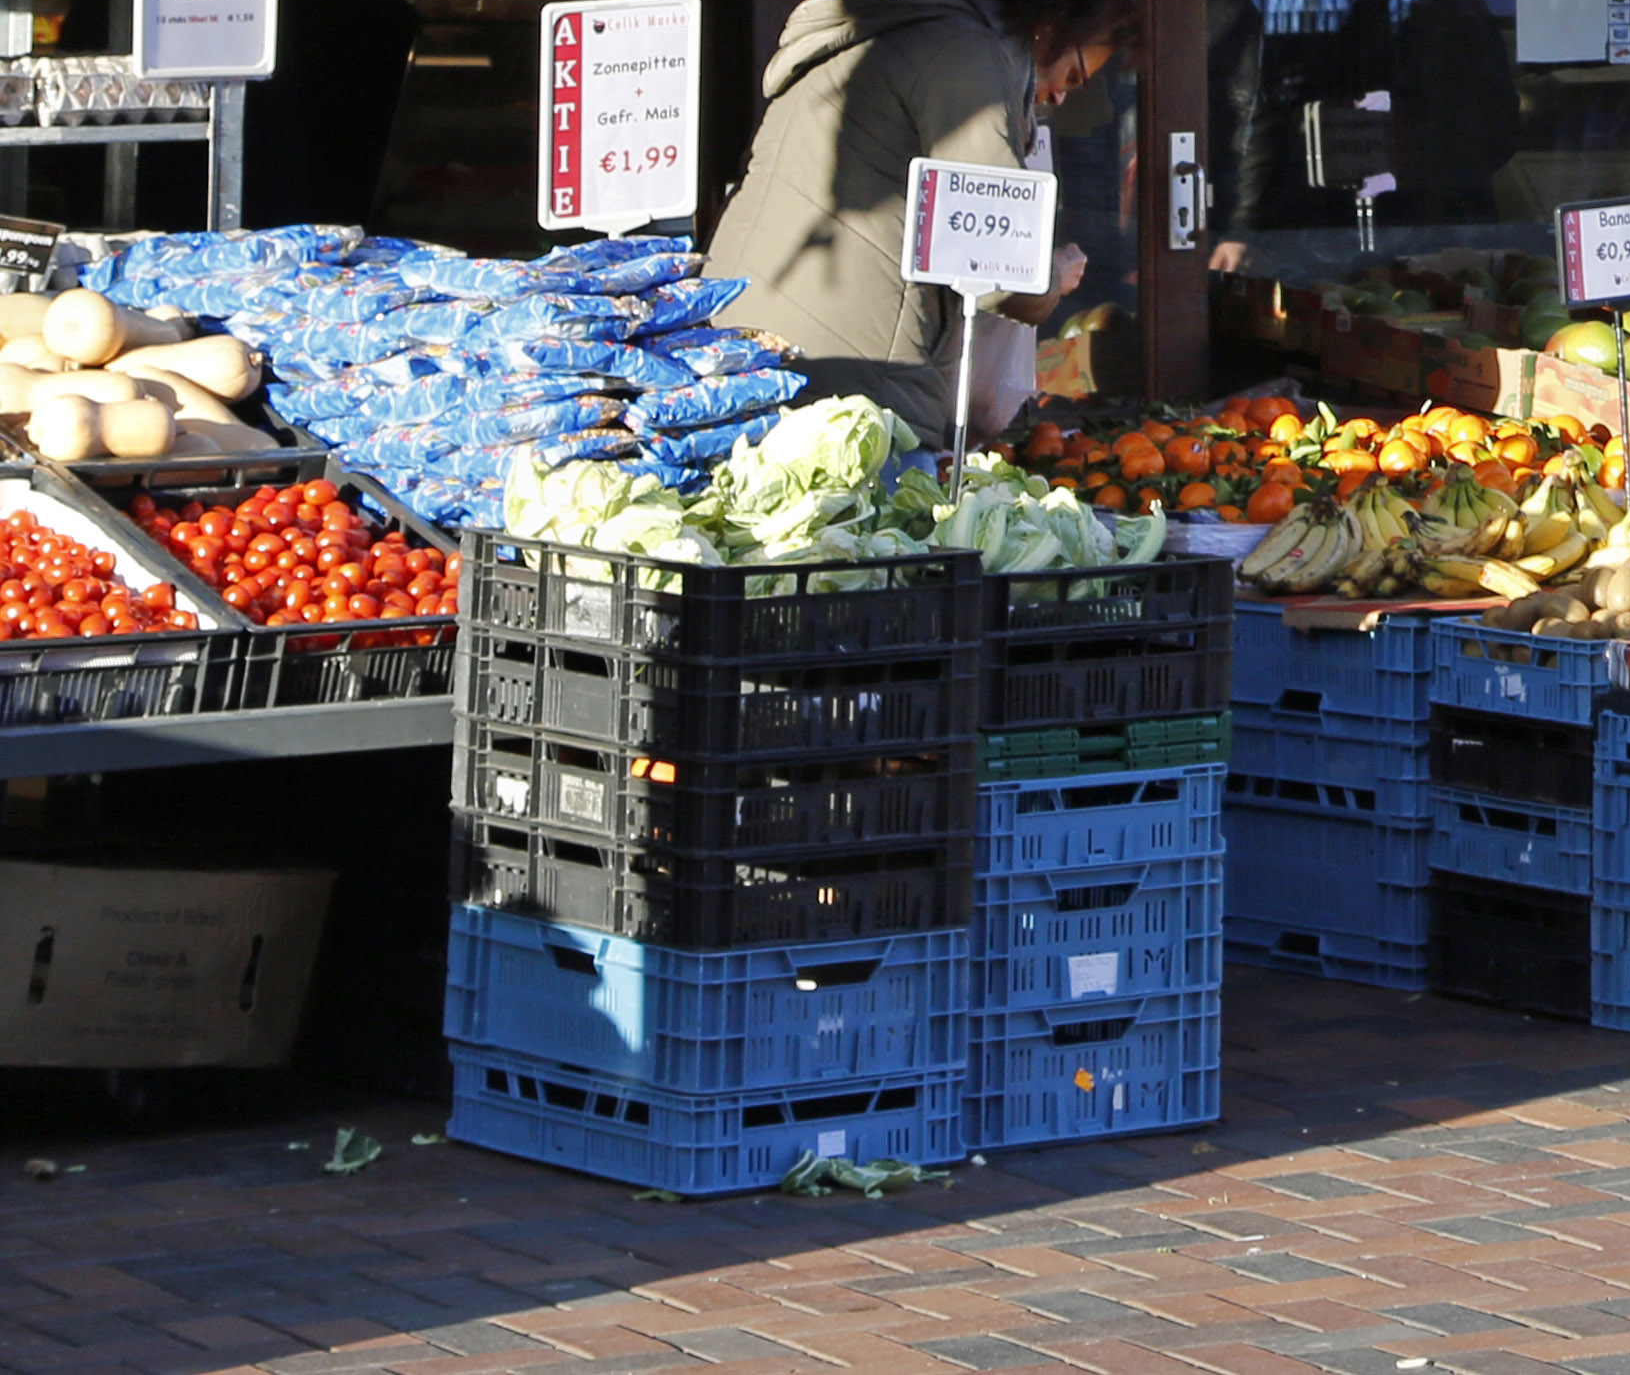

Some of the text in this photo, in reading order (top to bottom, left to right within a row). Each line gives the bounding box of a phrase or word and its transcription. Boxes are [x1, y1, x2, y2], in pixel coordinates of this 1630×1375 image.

[648, 13, 691, 29] Marke
[593, 56, 687, 76] Zonnepitten
[554, 17, 578, 215] AKTIE
[597, 105, 681, 126] Gefr. Mais
[600, 145, 678, 174] €1,99
[950, 173, 1037, 202] Bloemkool
[948, 210, 1011, 238] €0,99
[0, 247, 28, 265] ,99
